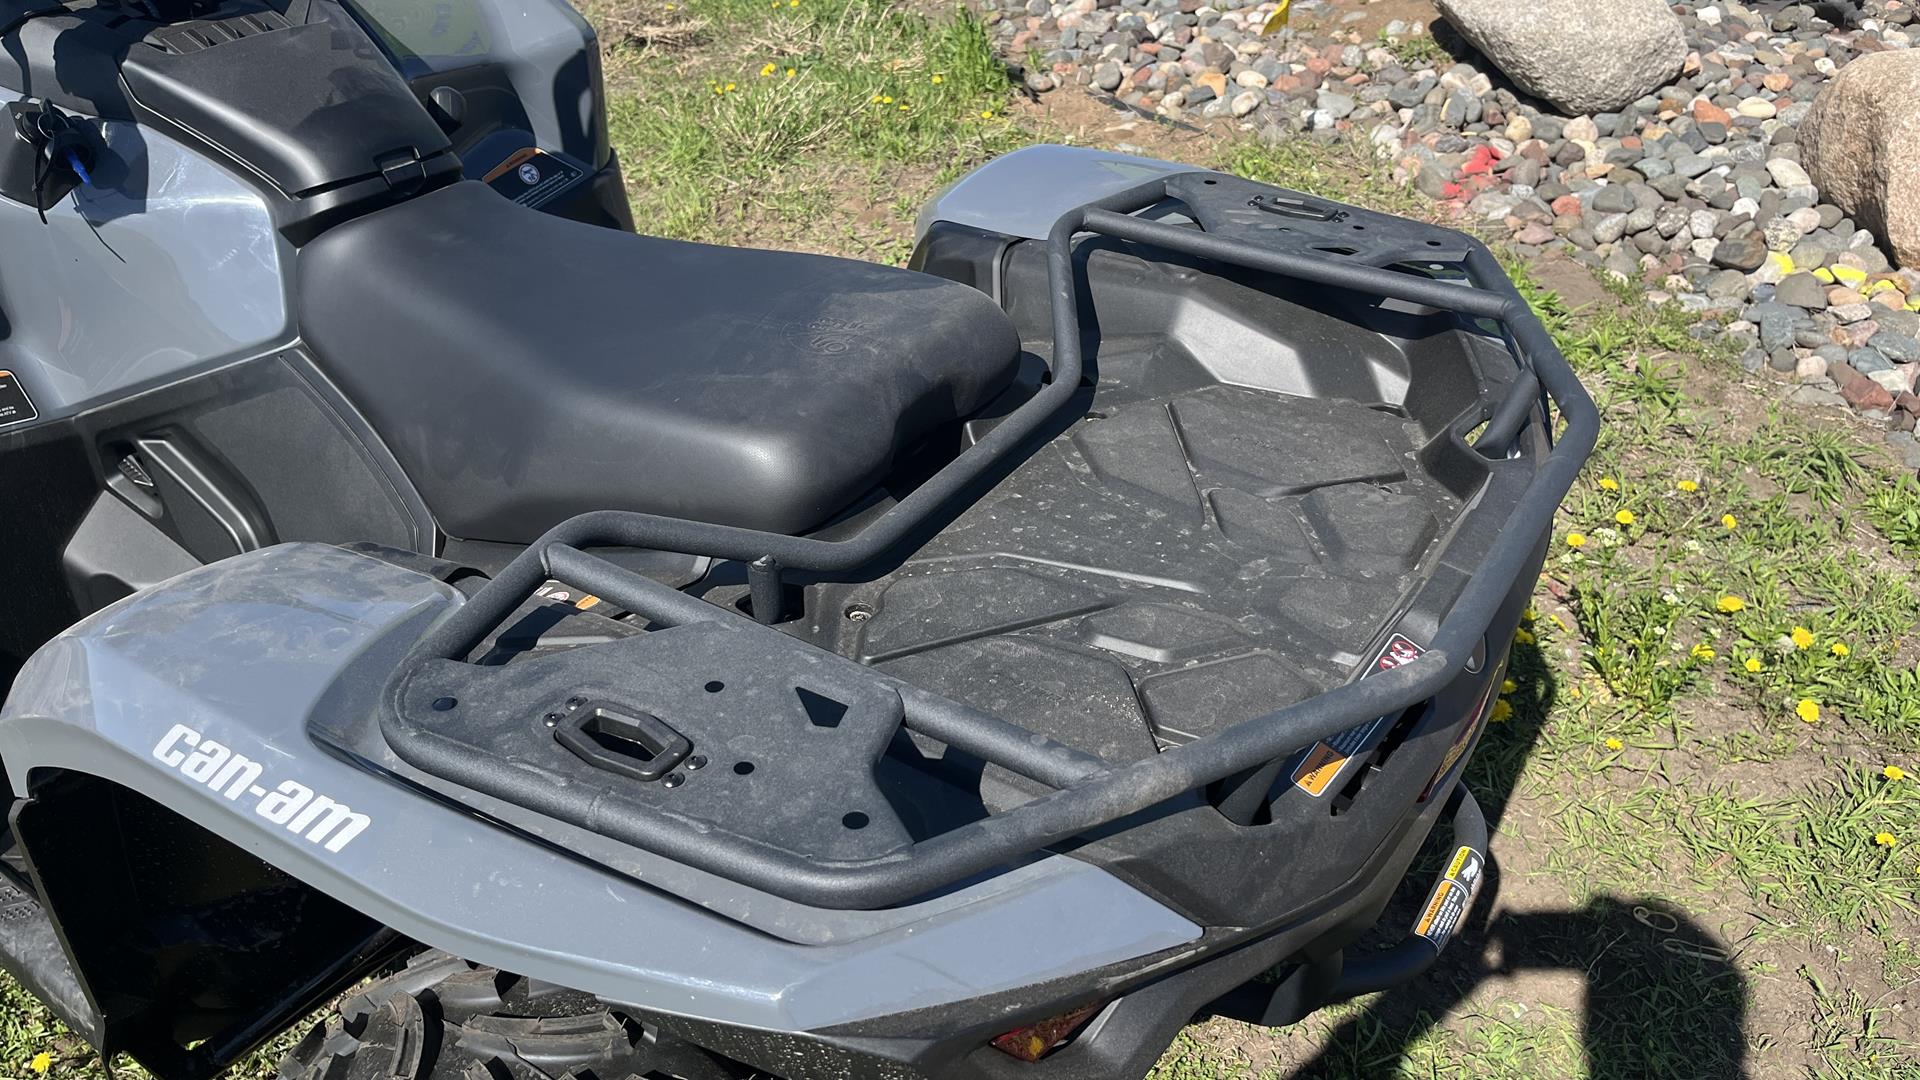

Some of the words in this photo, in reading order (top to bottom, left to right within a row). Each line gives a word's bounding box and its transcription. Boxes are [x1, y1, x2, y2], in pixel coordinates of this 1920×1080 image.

[1309, 750, 1334, 781] WARNING
[152, 723, 371, 853] can-am
[1452, 849, 1467, 873] CAUTION
[1427, 892, 1444, 918] WARNING
